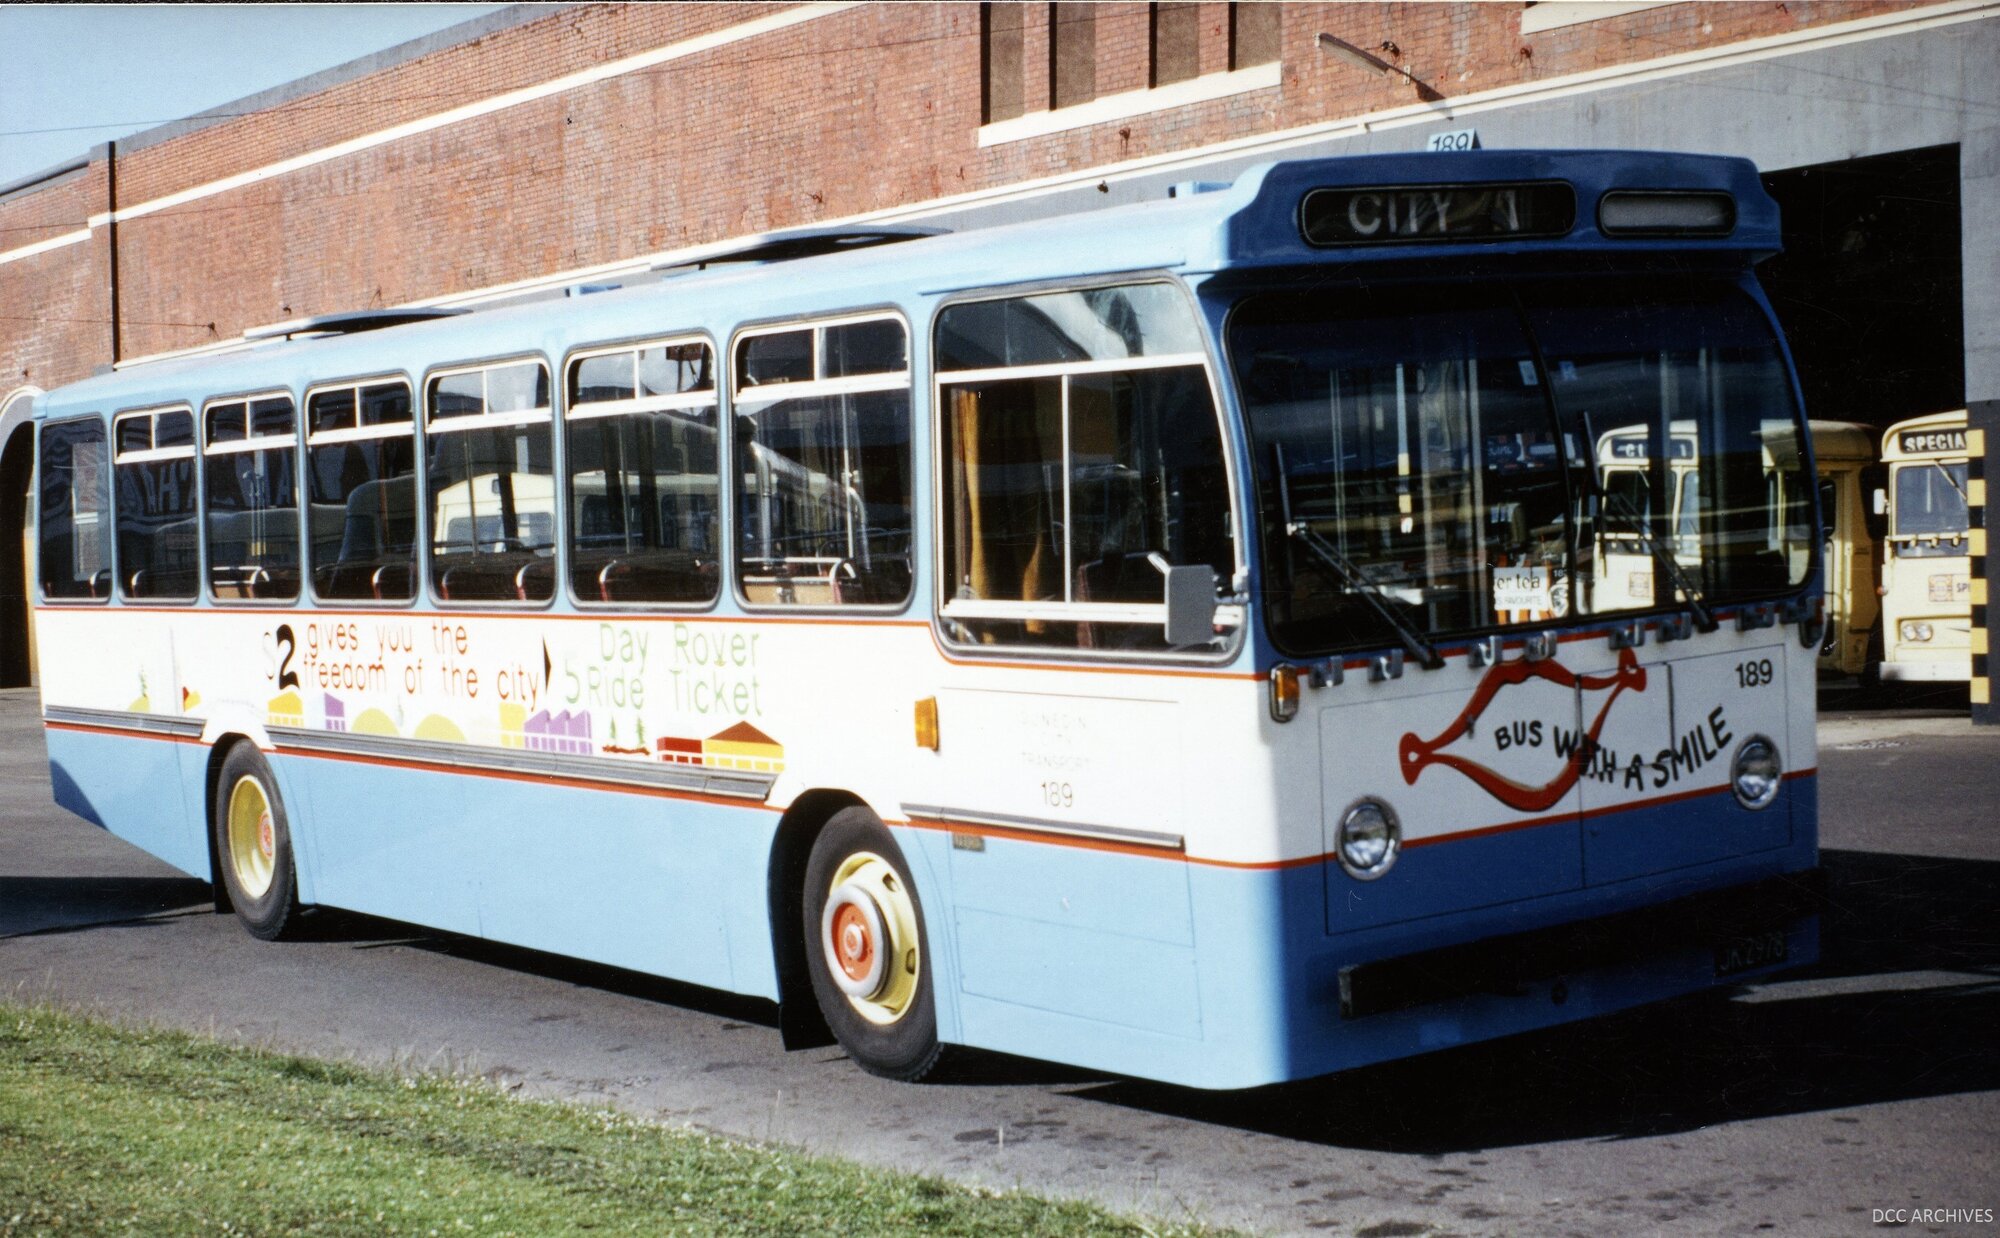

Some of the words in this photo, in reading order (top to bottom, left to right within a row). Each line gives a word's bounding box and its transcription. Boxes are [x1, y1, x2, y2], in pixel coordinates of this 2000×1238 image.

[1433, 132, 1469, 152] 189
[1348, 192, 1453, 235] CITY
[1904, 432, 1967, 452] SPECIA
[307, 623, 358, 659] gives
[376, 624, 412, 661] you
[432, 619, 467, 655] the
[600, 623, 648, 675] Day
[674, 622, 760, 667] Rover
[303, 652, 387, 692] freedom
[405, 658, 422, 694] of
[442, 659, 478, 698] the
[497, 662, 538, 712] city
[565, 657, 581, 704] 5
[588, 665, 644, 710] Ride
[669, 667, 762, 717] Ticket
[1735, 658, 1773, 688] 189
[1494, 720, 1542, 751] BUS
[1624, 753, 1644, 791] A
[1653, 706, 1733, 788] SMILE
[1041, 781, 1073, 808] 189
